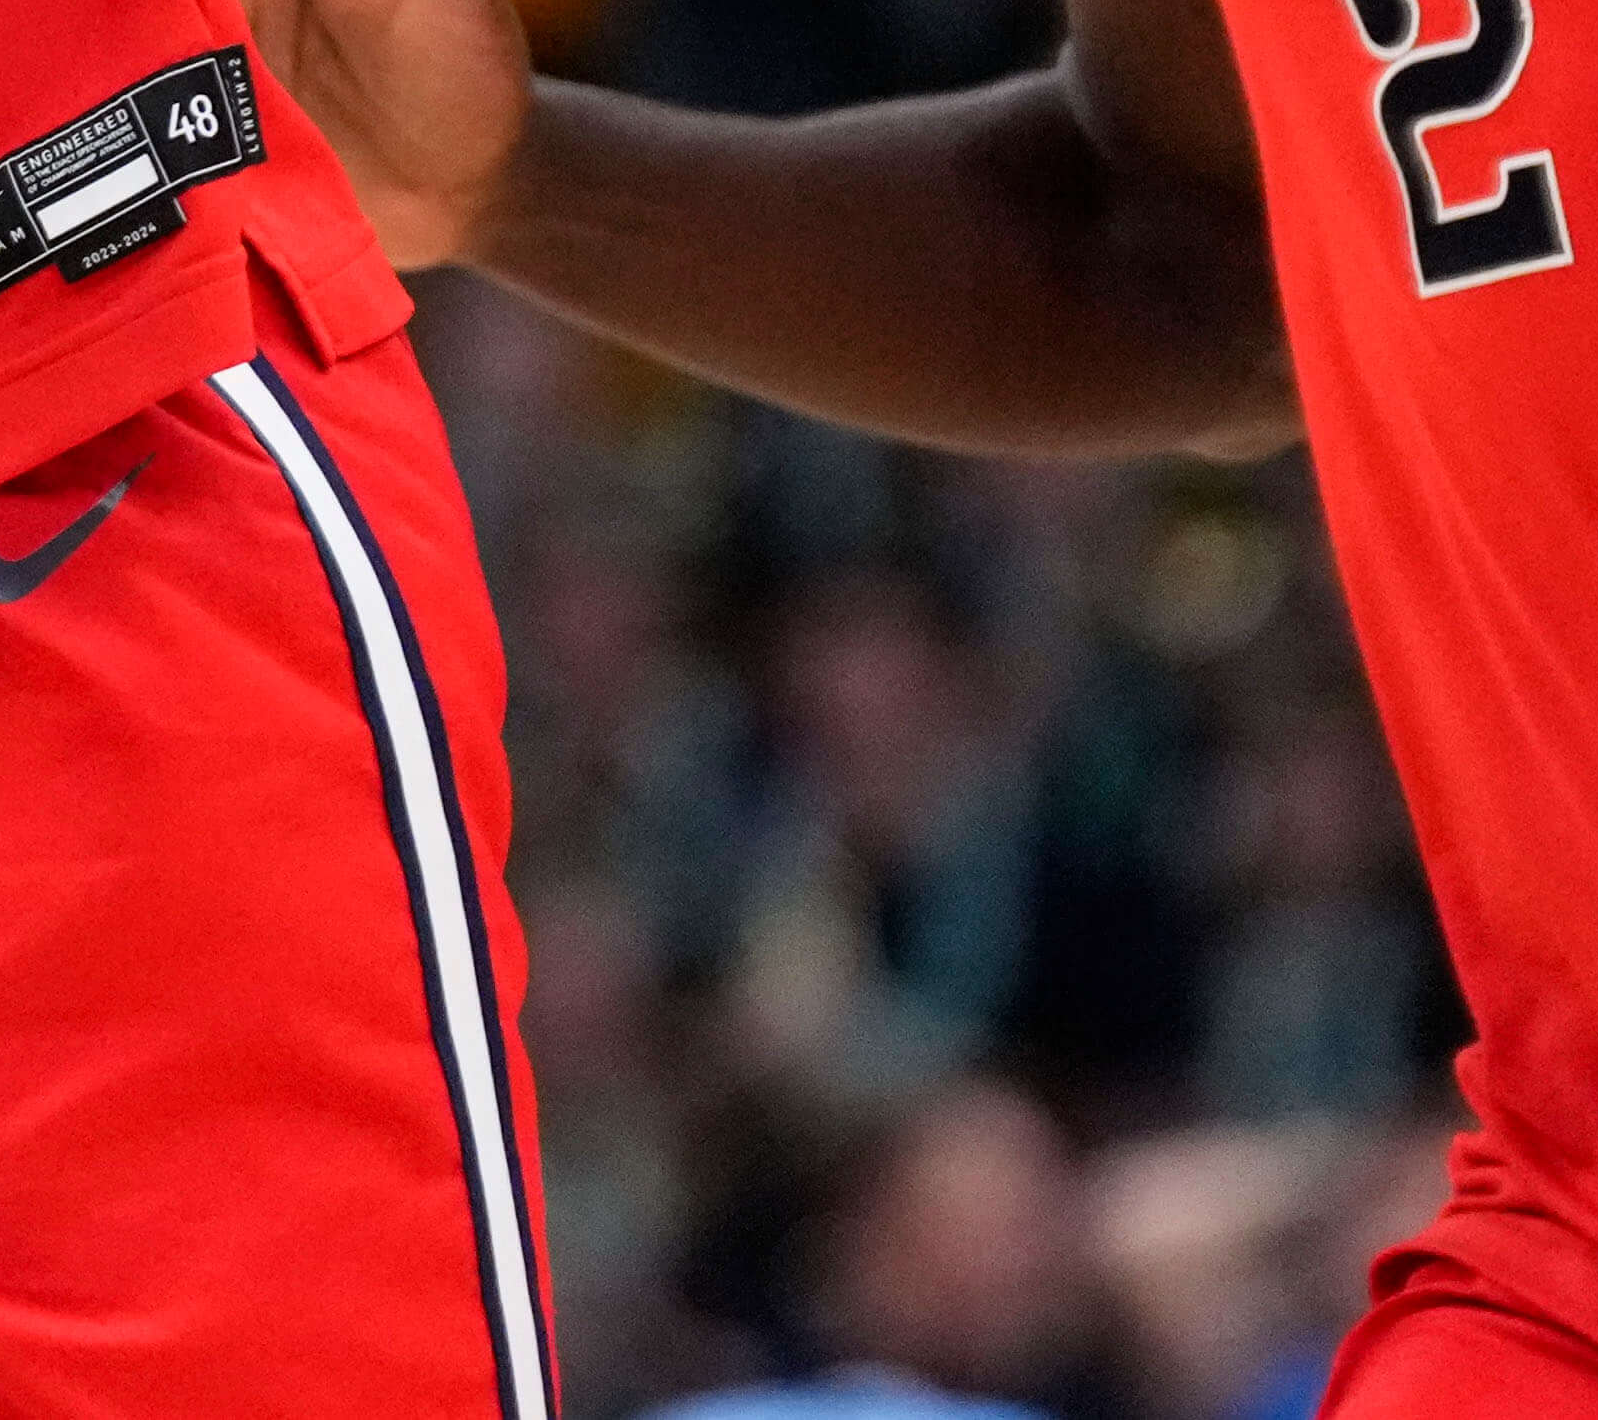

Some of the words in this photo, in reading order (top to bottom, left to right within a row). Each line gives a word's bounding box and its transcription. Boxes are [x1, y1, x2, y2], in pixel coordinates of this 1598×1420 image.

[16, 108, 129, 177] ENGINEERED
[167, 93, 220, 146] 48
[82, 221, 157, 270] 2023-2024
